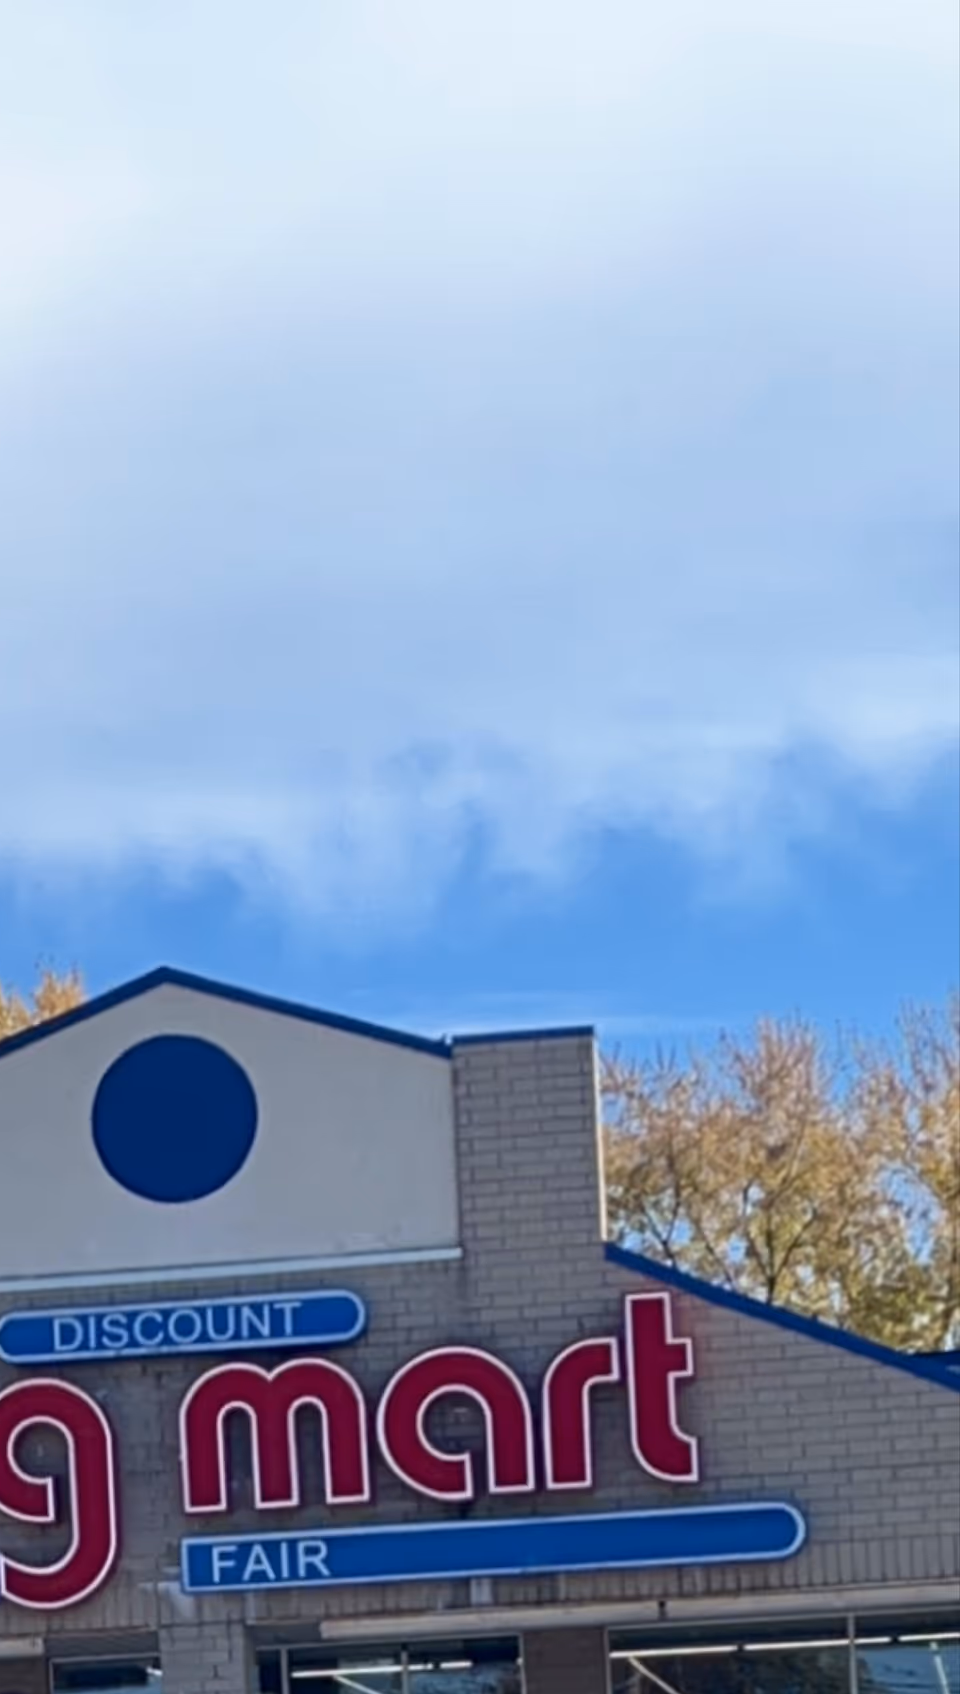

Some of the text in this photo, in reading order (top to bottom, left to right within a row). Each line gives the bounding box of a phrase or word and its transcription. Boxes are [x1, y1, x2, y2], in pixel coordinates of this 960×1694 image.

[52, 1301, 302, 1353] DISCOUNT
[180, 1292, 698, 1512] mart
[211, 1540, 331, 1583] FAIR
